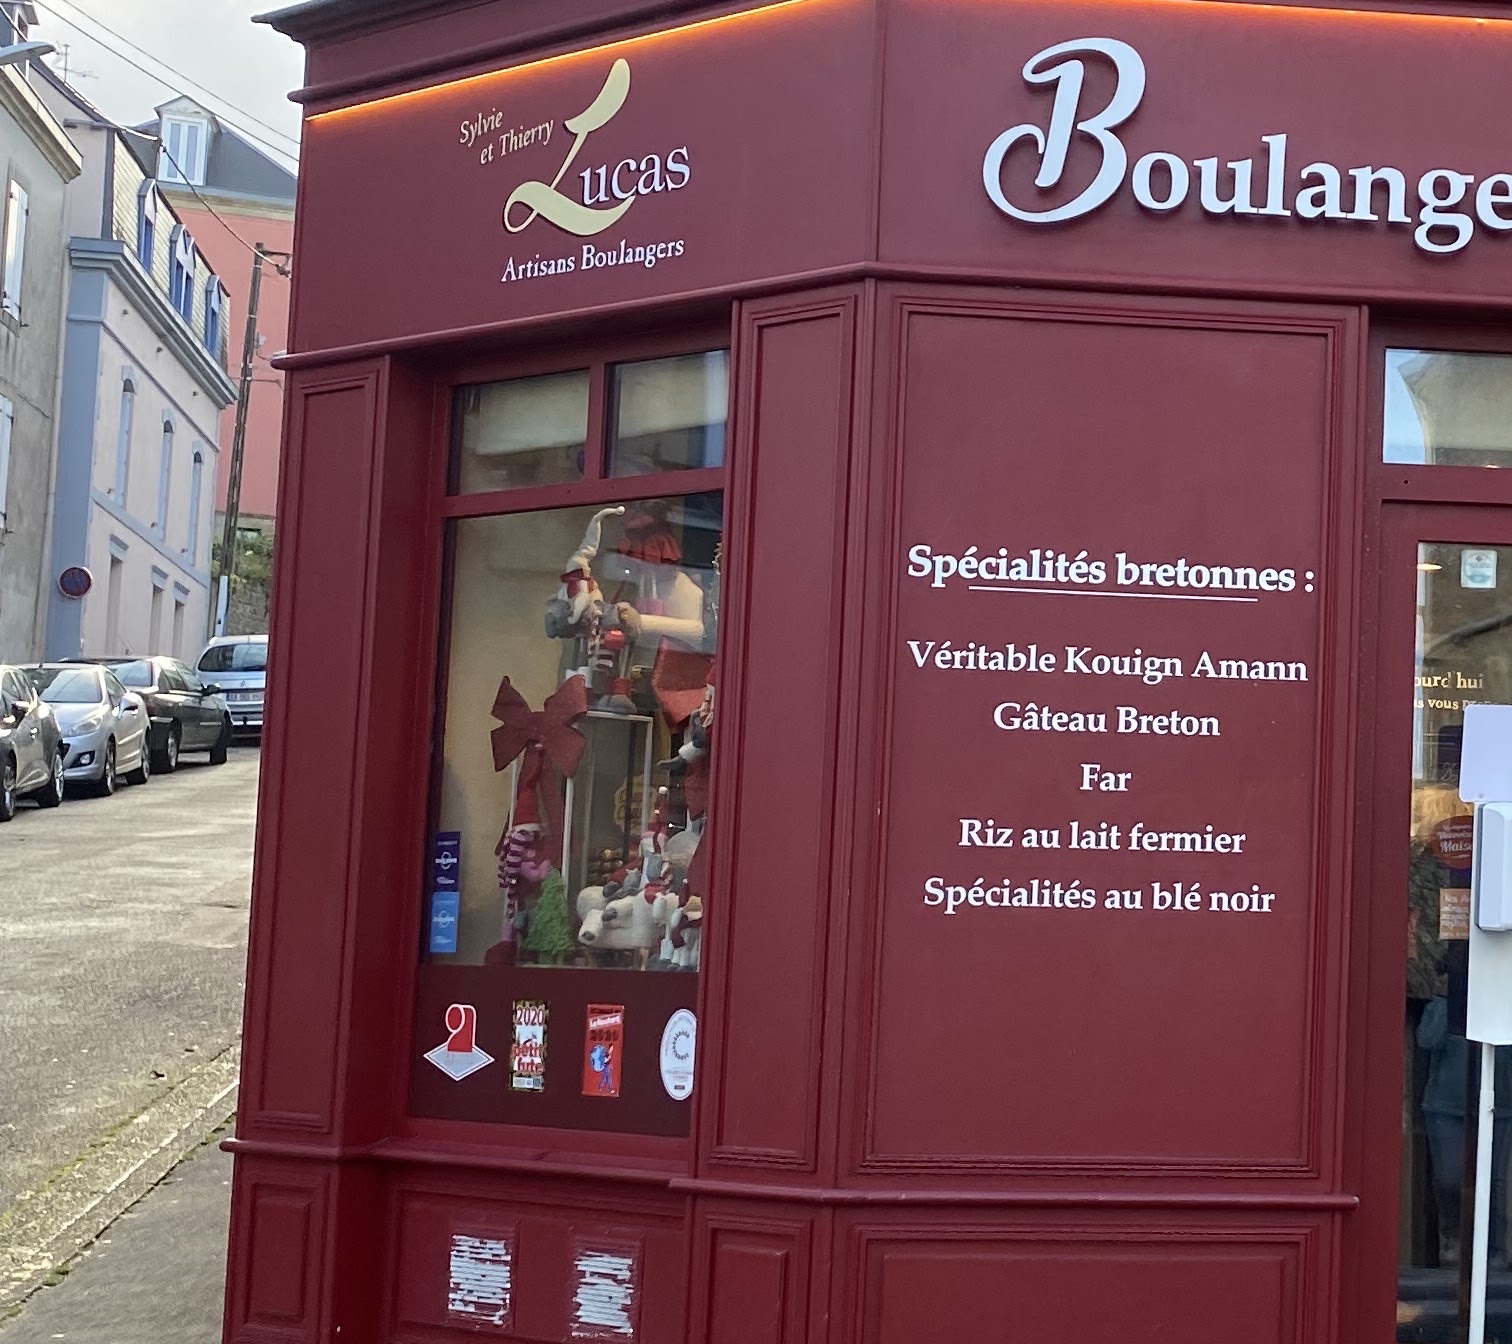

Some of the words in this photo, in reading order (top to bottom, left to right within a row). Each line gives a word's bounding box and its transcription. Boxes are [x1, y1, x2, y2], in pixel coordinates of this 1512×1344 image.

[459, 107, 504, 148] Sylvie
[479, 144, 495, 165] et
[498, 119, 554, 158] Thierry
[503, 58, 692, 236] Lucas
[501, 254, 575, 282] Artisans
[581, 239, 685, 270] Boulangers
[907, 544, 1106, 588] Spécialités
[1115, 552, 1296, 592] bretonnes
[906, 640, 1057, 674] Véritable
[1064, 646, 1184, 685] Kouign
[1191, 651, 1308, 681] Amann
[993, 702, 1108, 733] Gâteau
[1116, 706, 1221, 736] Breton
[1427, 699, 1459, 710] vous
[1079, 763, 1132, 792] Far
[958, 818, 1014, 848] Riz
[1021, 827, 1061, 849] au
[1068, 821, 1121, 851] lait
[1128, 823, 1247, 853] fermier
[923, 877, 1097, 916] Spécialités
[1104, 887, 1144, 910] au
[1151, 881, 1201, 912] blé
[1208, 884, 1276, 913] noir
[515, 1007, 545, 1027] 2020
